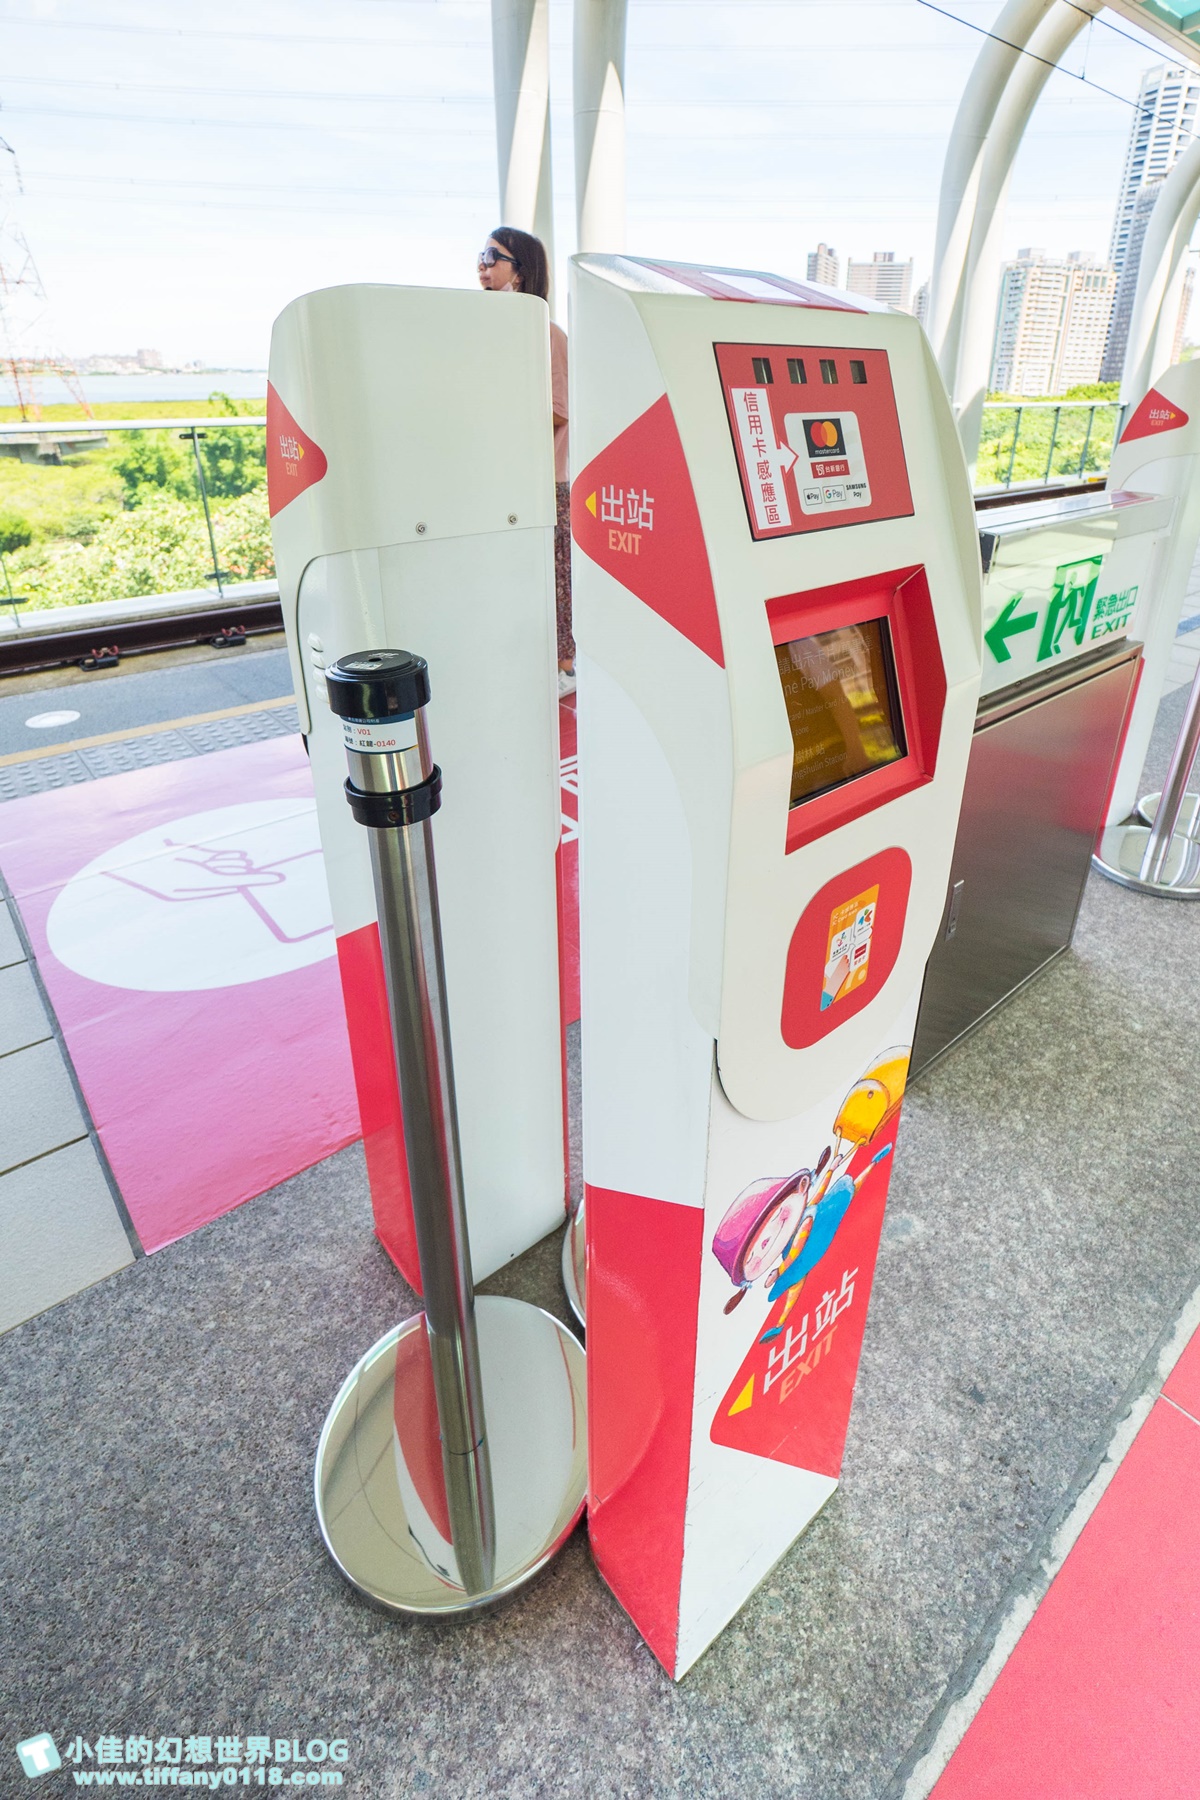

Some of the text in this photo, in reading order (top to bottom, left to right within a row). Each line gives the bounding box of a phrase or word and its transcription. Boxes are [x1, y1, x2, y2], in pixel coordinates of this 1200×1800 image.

[1149, 409, 1170, 420] 出站
[279, 434, 300, 461] 出站
[743, 391, 782, 525] 信用卡感應區
[814, 447, 841, 455] mastercard
[810, 492, 820, 501] Pay
[832, 489, 843, 499] Pay
[846, 482, 867, 490] SAMSUNG
[601, 484, 655, 531] 出站
[608, 528, 642, 556] EXIT
[1093, 585, 1139, 622] 緊急出口
[1090, 612, 1132, 640] EXIT
[801, 676, 820, 692] Pay
[822, 665, 857, 685] Money
[824, 752, 849, 767] Station
[763, 1266, 859, 1395] 出站
[779, 1324, 839, 1405] EXIT
